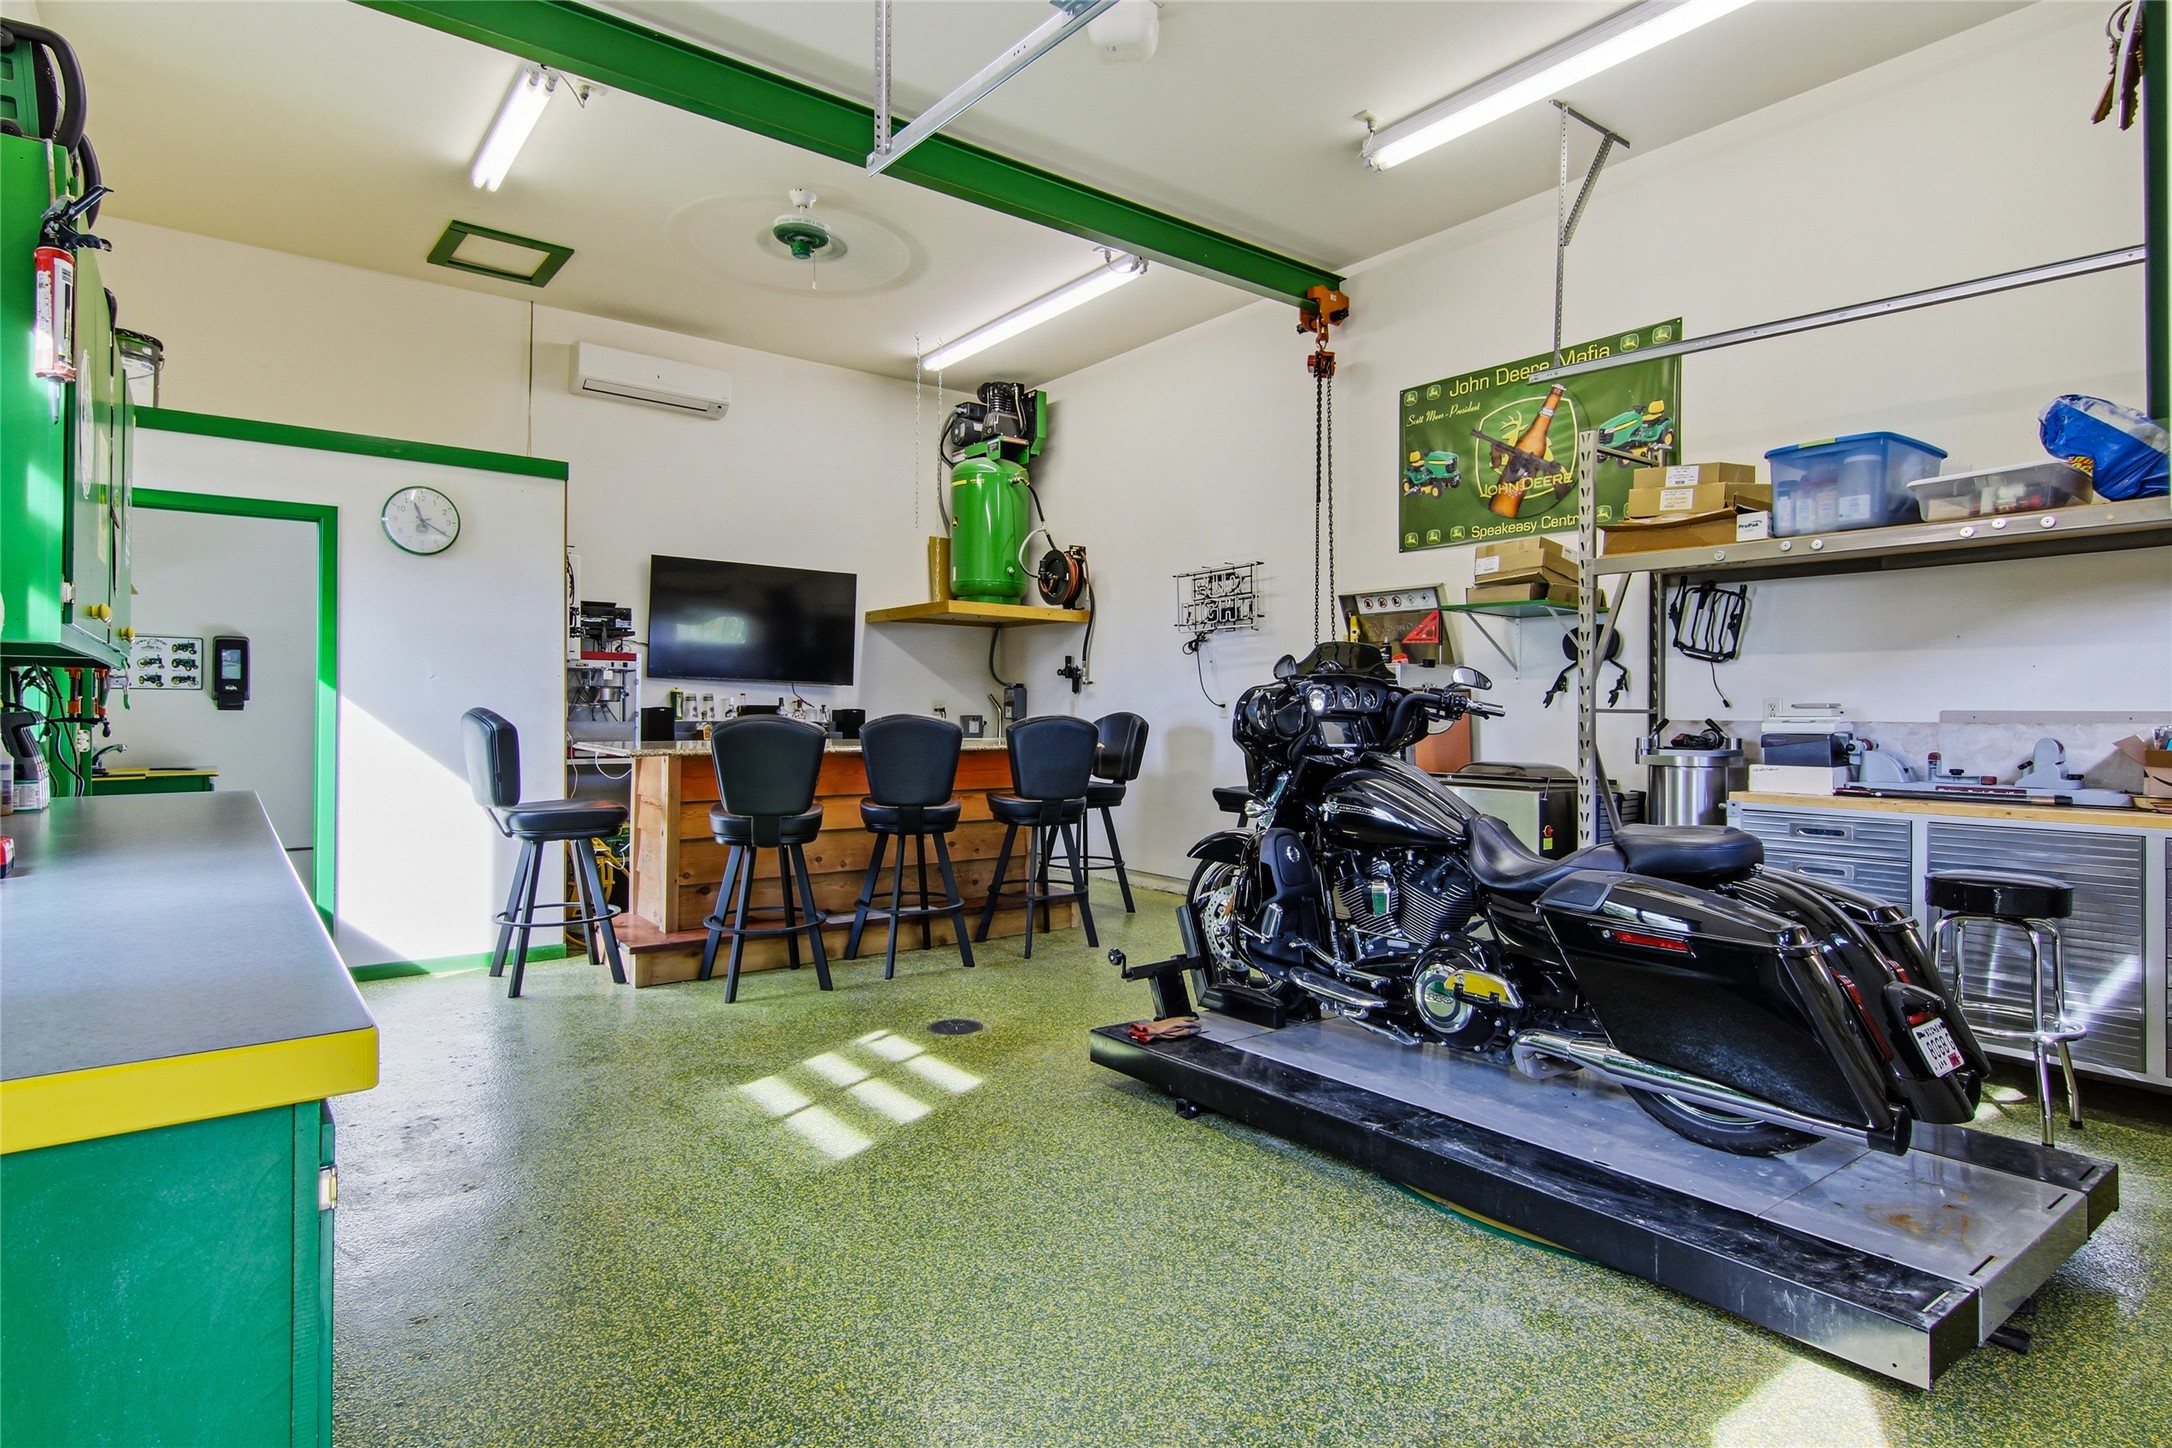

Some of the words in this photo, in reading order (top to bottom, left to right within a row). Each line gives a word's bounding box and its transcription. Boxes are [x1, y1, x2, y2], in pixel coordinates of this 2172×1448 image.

[1449, 374, 1490, 398] John
[1406, 413, 1425, 427] Scott
[1448, 400, 1481, 418] President
[1481, 480, 1520, 498] JOHN
[1521, 471, 1574, 491] DEERE
[1471, 520, 1538, 540] Speakeasy
[1541, 513, 1580, 529] Centr
